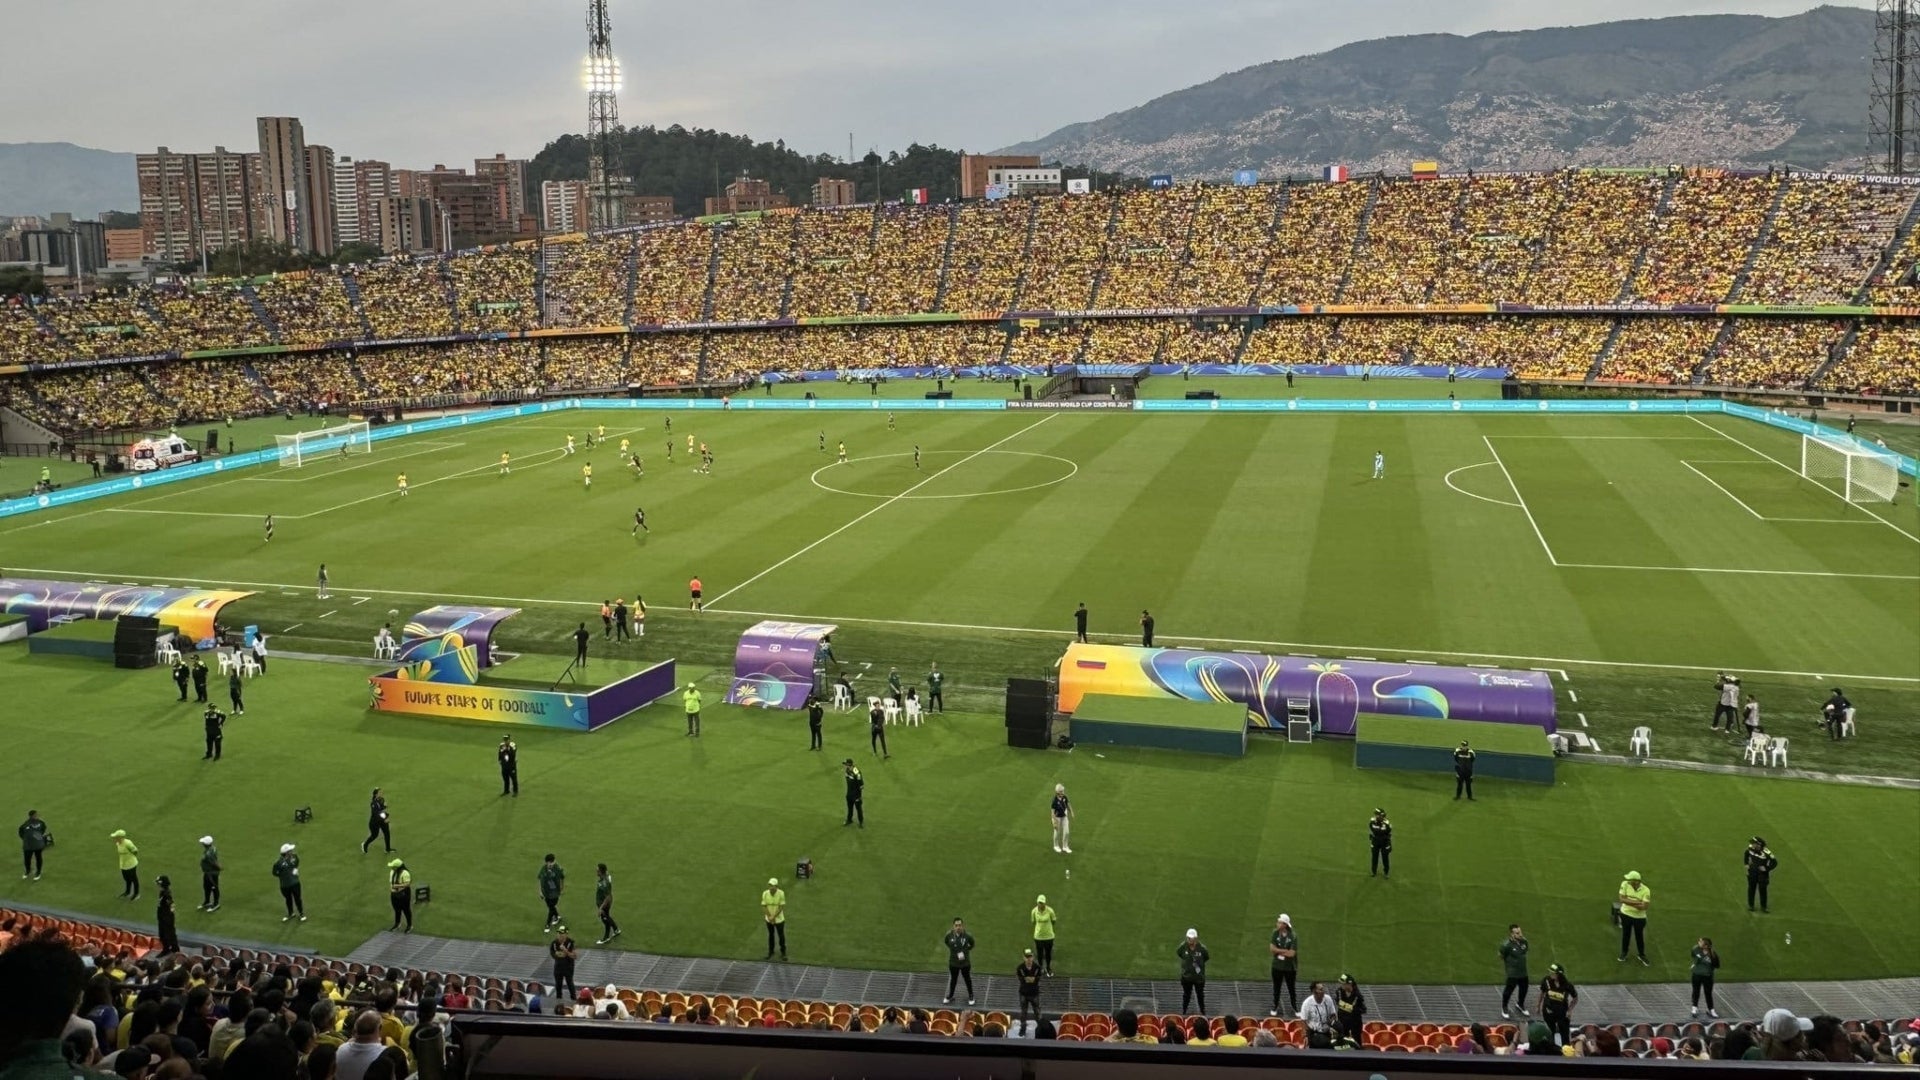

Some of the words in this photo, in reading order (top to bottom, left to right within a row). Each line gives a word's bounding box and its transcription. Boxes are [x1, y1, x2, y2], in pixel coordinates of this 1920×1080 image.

[1866, 175, 1900, 184] WORLD
[1901, 177, 1920, 186] CUP
[404, 691, 442, 706] FUTURE
[446, 694, 477, 709] STARS
[482, 698, 494, 711] OF
